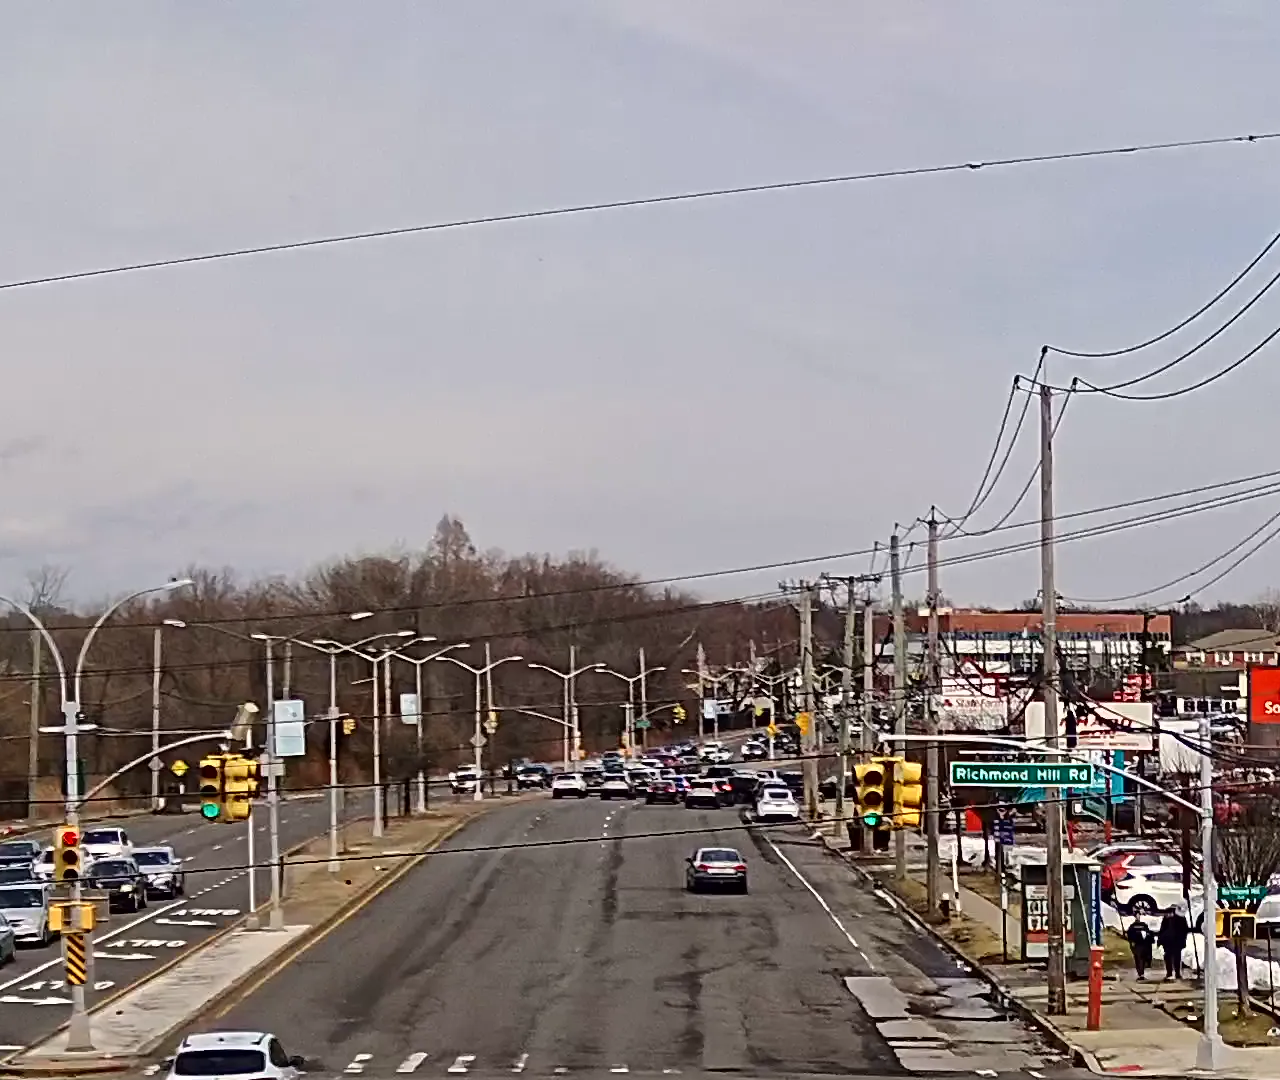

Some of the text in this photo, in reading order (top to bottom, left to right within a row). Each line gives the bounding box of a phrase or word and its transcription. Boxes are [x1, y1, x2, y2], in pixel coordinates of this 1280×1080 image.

[956, 767, 1088, 781] Richmond Hill Rd
[18, 980, 116, 991] OLY
